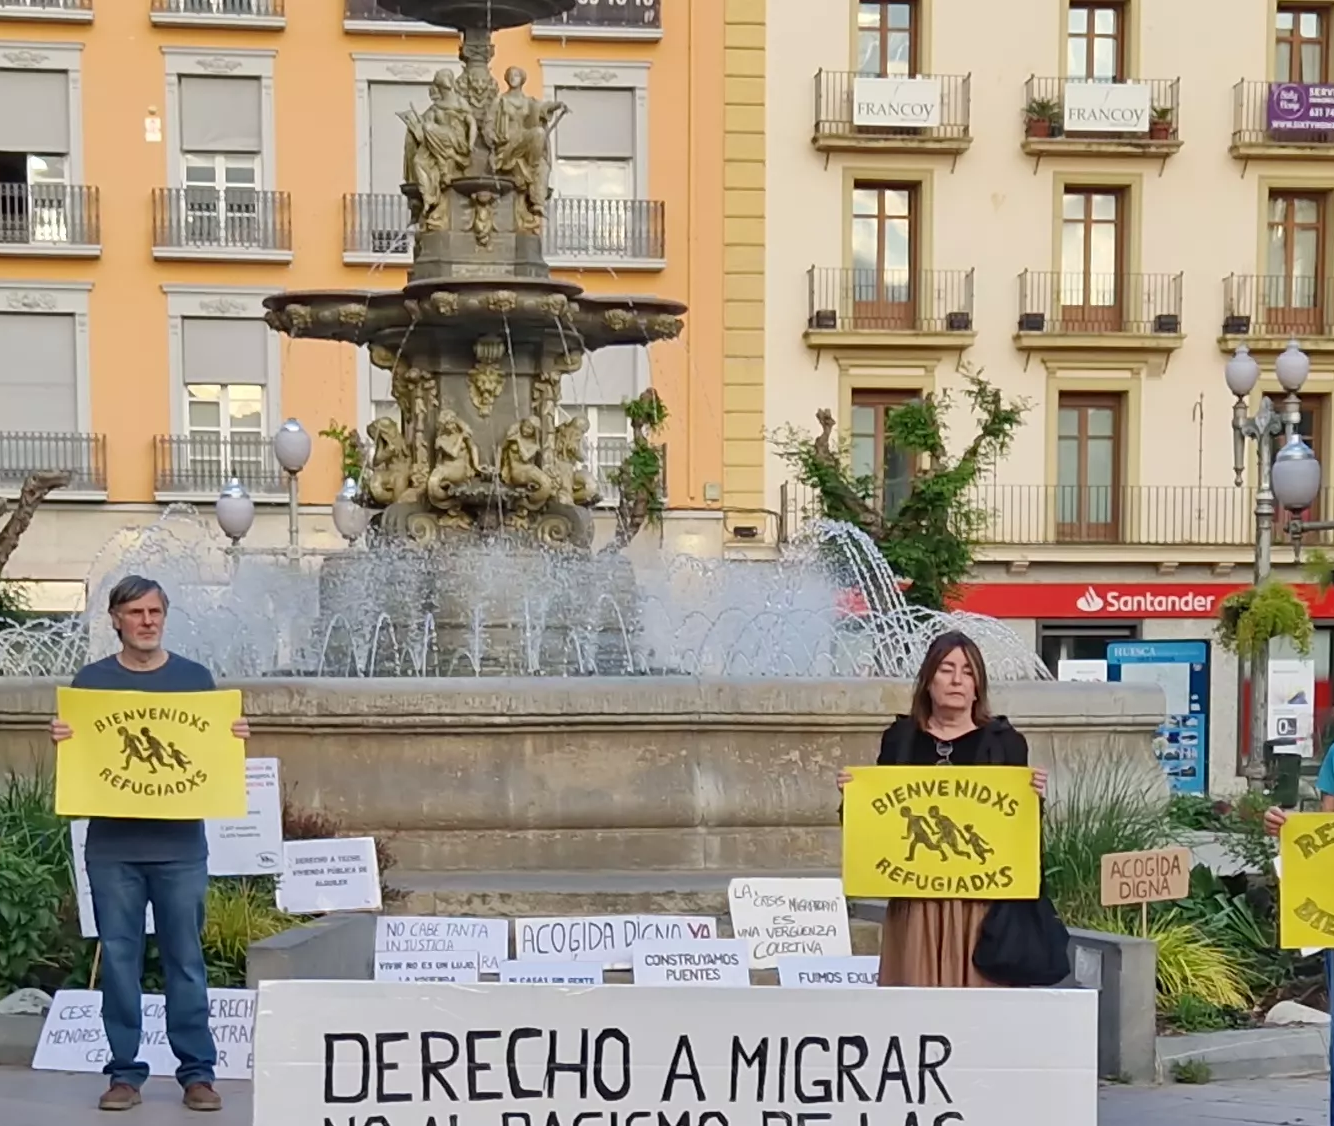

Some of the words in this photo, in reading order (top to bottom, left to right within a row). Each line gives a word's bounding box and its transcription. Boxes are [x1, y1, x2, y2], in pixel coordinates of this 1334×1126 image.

[857, 102, 935, 122] FRANCOY
[1067, 107, 1145, 127] FRANCOY
[1106, 591, 1215, 612] Santander
[93, 707, 211, 734] BIENVENIDXS
[98, 767, 208, 797] REFUGIADXS
[871, 779, 1020, 818] BIENVENIDXS
[874, 856, 1014, 894] REFUGIADXS
[1110, 853, 1181, 880] ACOGIDA
[733, 884, 751, 899] LA
[1119, 877, 1171, 900] DIGNA
[386, 921, 405, 938] NO
[410, 922, 440, 938] CABE
[446, 922, 489, 939] TANTA
[772, 915, 796, 925] ES
[522, 921, 615, 953] ACOGIDA
[737, 926, 760, 938] UNA
[644, 953, 740, 966] CONSTRUYAMOS
[753, 939, 824, 960] COLECTIVA
[378, 961, 403, 970] VIVIR
[405, 961, 418, 970] NO
[421, 961, 433, 970] ES
[435, 961, 448, 970] UN
[665, 969, 721, 982] PUENTES
[798, 972, 843, 985] FUIMOS
[323, 1026, 631, 1104] DERECHO
[660, 1034, 707, 1102] A
[729, 1034, 954, 1105] MIGRAR
